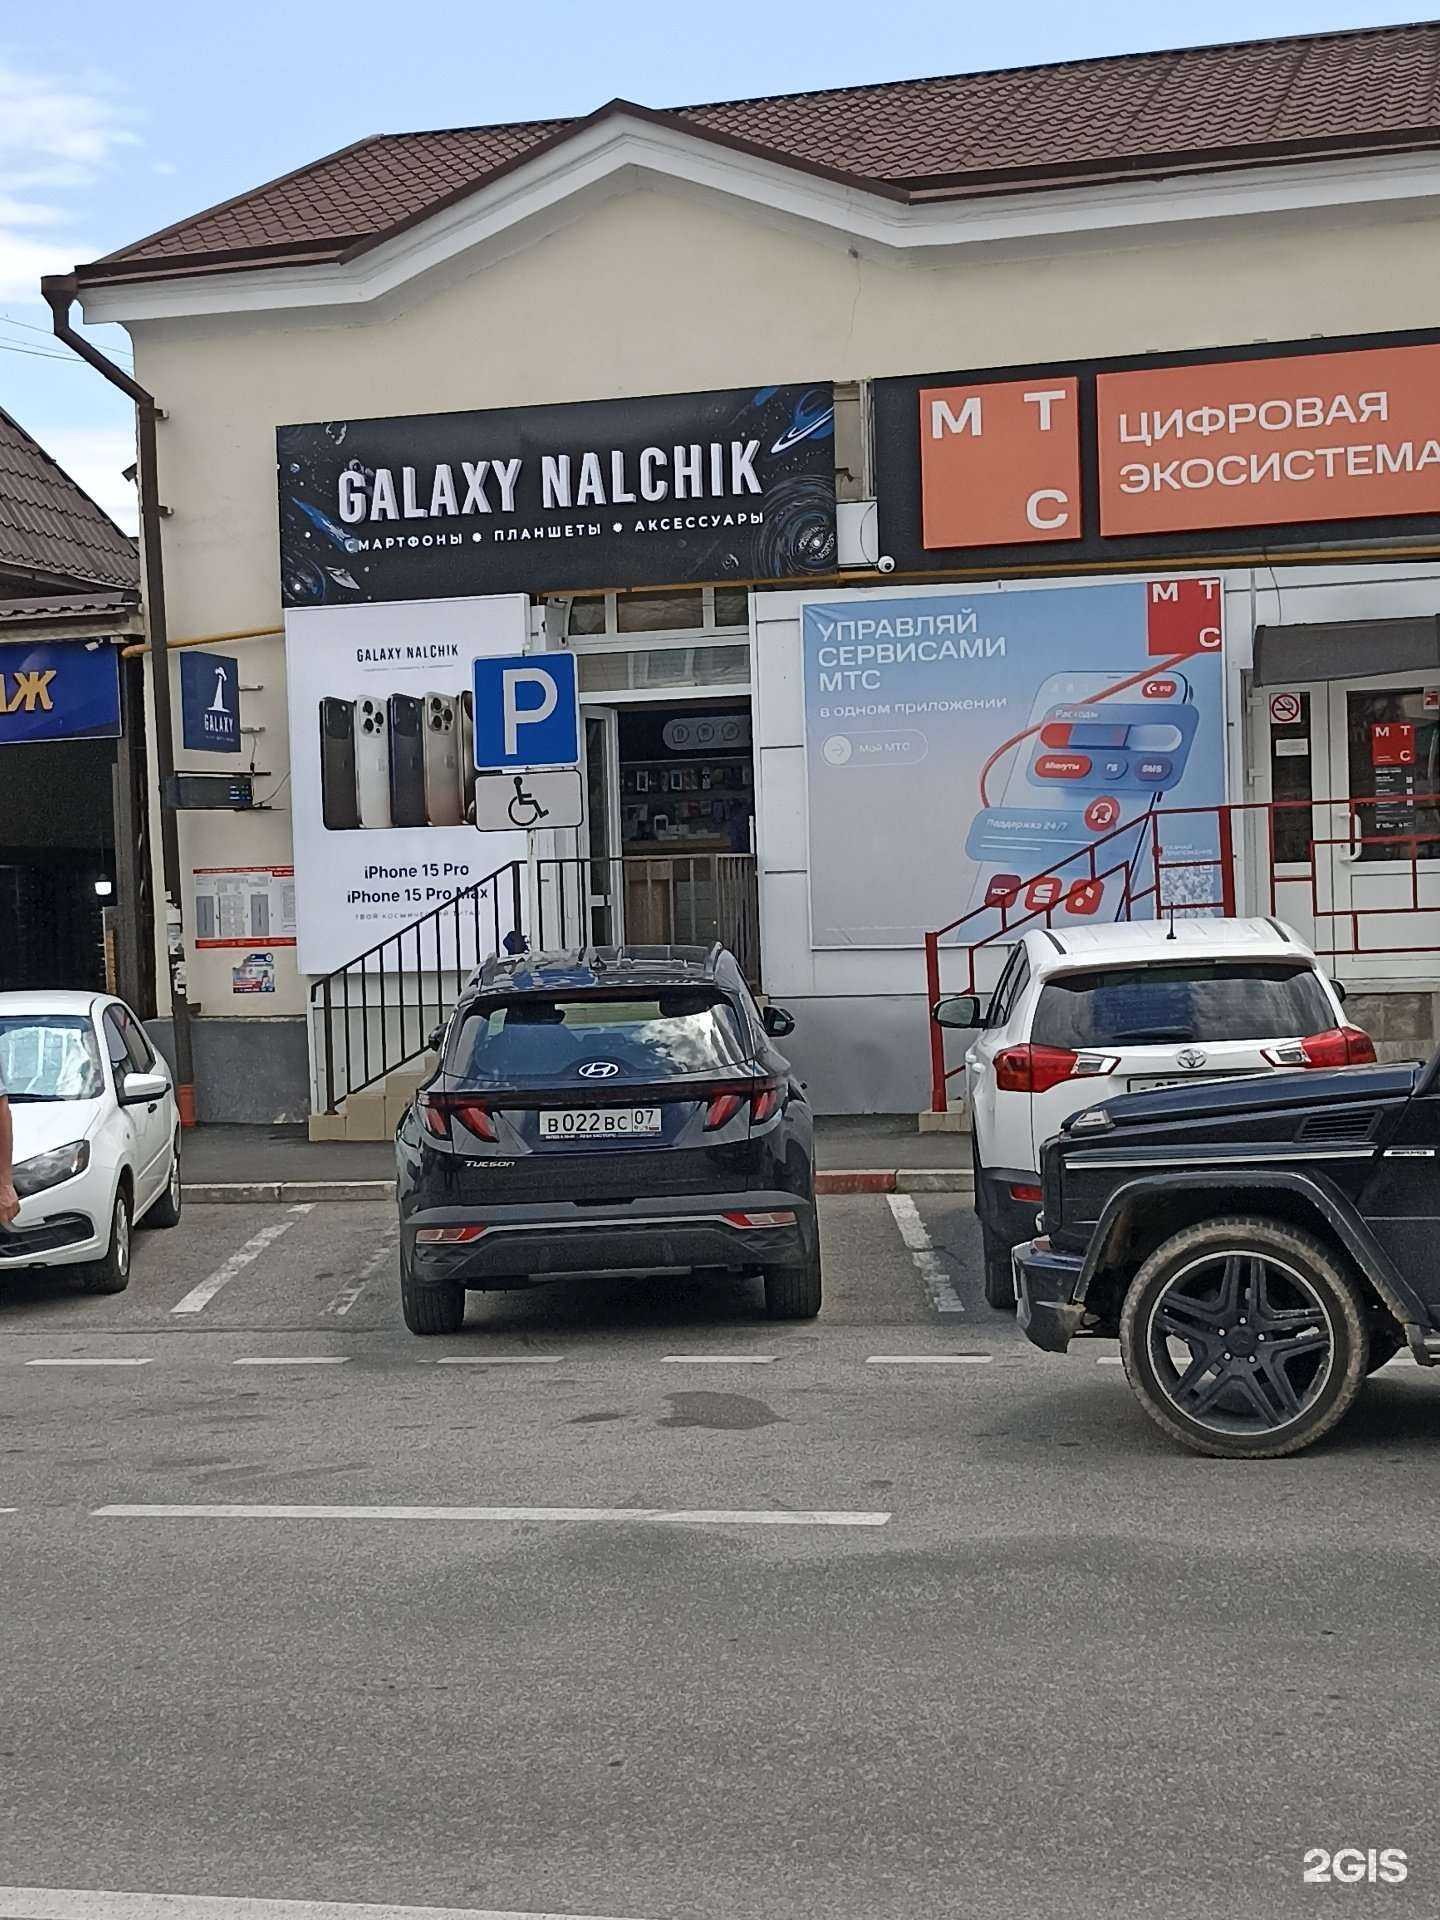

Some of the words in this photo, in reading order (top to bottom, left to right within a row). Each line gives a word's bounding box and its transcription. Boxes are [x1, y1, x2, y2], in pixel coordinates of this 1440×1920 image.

[1119, 391, 1389, 447] ЦИФРОВАЯ
[338, 459, 522, 524] GALAXY
[541, 440, 763, 509] NALCHIK
[1119, 439, 1440, 494] ЭКОСИСТЕМА
[346, 532, 464, 553] СМАРТФОНЫ
[494, 524, 601, 542] ПЛАНШЕТЫ
[634, 512, 764, 533] АКСЕССУАРЫ
[817, 608, 977, 642] УПРАВЛЯЙ
[356, 648, 401, 663] GALAXY
[407, 644, 458, 659] NALCHIK
[818, 637, 1006, 667] СЕРВИСАМИ
[0, 670, 57, 712] Ж
[819, 669, 881, 692] МТС
[204, 713, 234, 734] GALAXY
[502, 667, 558, 756] P
[819, 706, 830, 718] в
[833, 703, 891, 719] одном
[894, 697, 1008, 717] приложении
[364, 865, 418, 880] iPhone
[421, 863, 440, 877] 15
[443, 862, 470, 876] Pro
[346, 890, 401, 904] iPhone
[404, 888, 422, 901] 15
[425, 887, 452, 900] Pro
